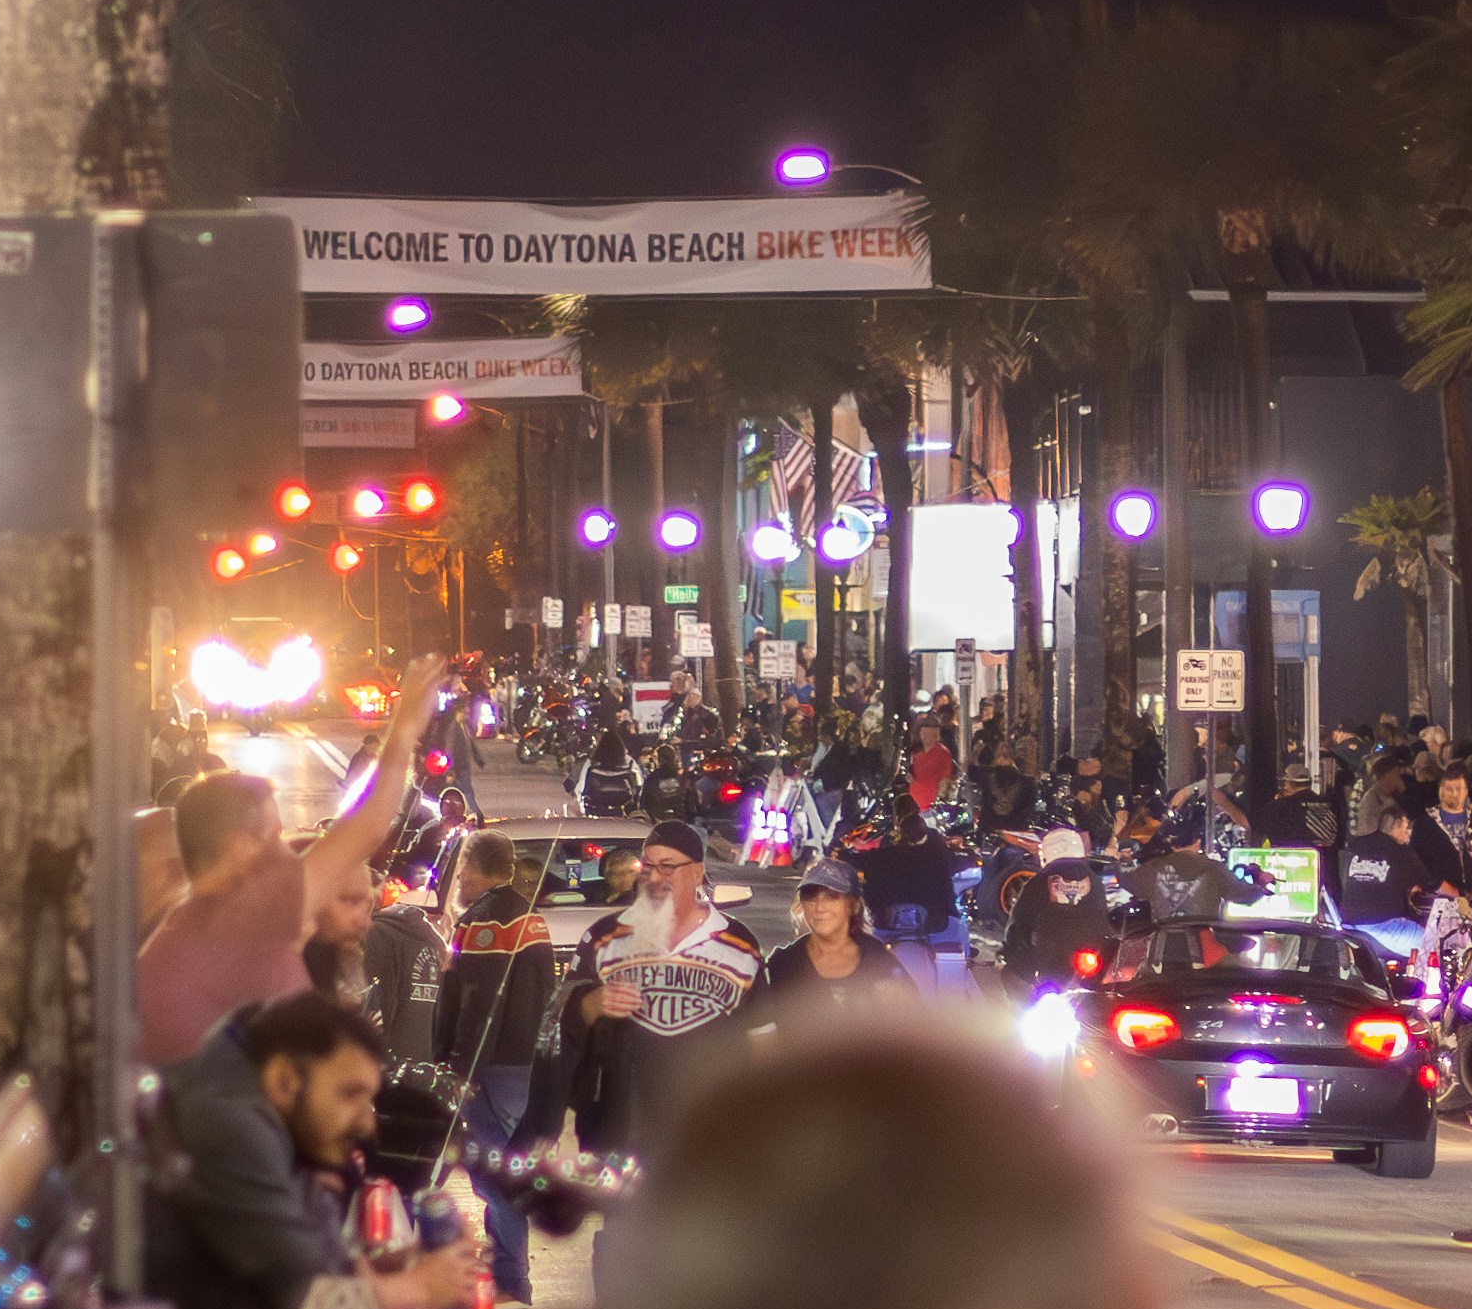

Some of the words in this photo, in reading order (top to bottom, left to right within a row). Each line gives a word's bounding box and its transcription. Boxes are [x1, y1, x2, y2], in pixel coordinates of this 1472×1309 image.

[303, 228, 449, 262] WELCOME
[458, 233, 494, 263] TO
[503, 232, 638, 263] DAYTONA
[648, 231, 744, 262] BEACH
[757, 229, 826, 259] BIKE
[832, 226, 916, 260] WEEK
[321, 361, 403, 381] DAYTONA
[408, 360, 468, 381] BEACH
[475, 358, 515, 379] BIKE
[1221, 656, 1234, 667] NO
[1212, 670, 1242, 680] PARKING
[643, 994, 706, 1026] YCLES
